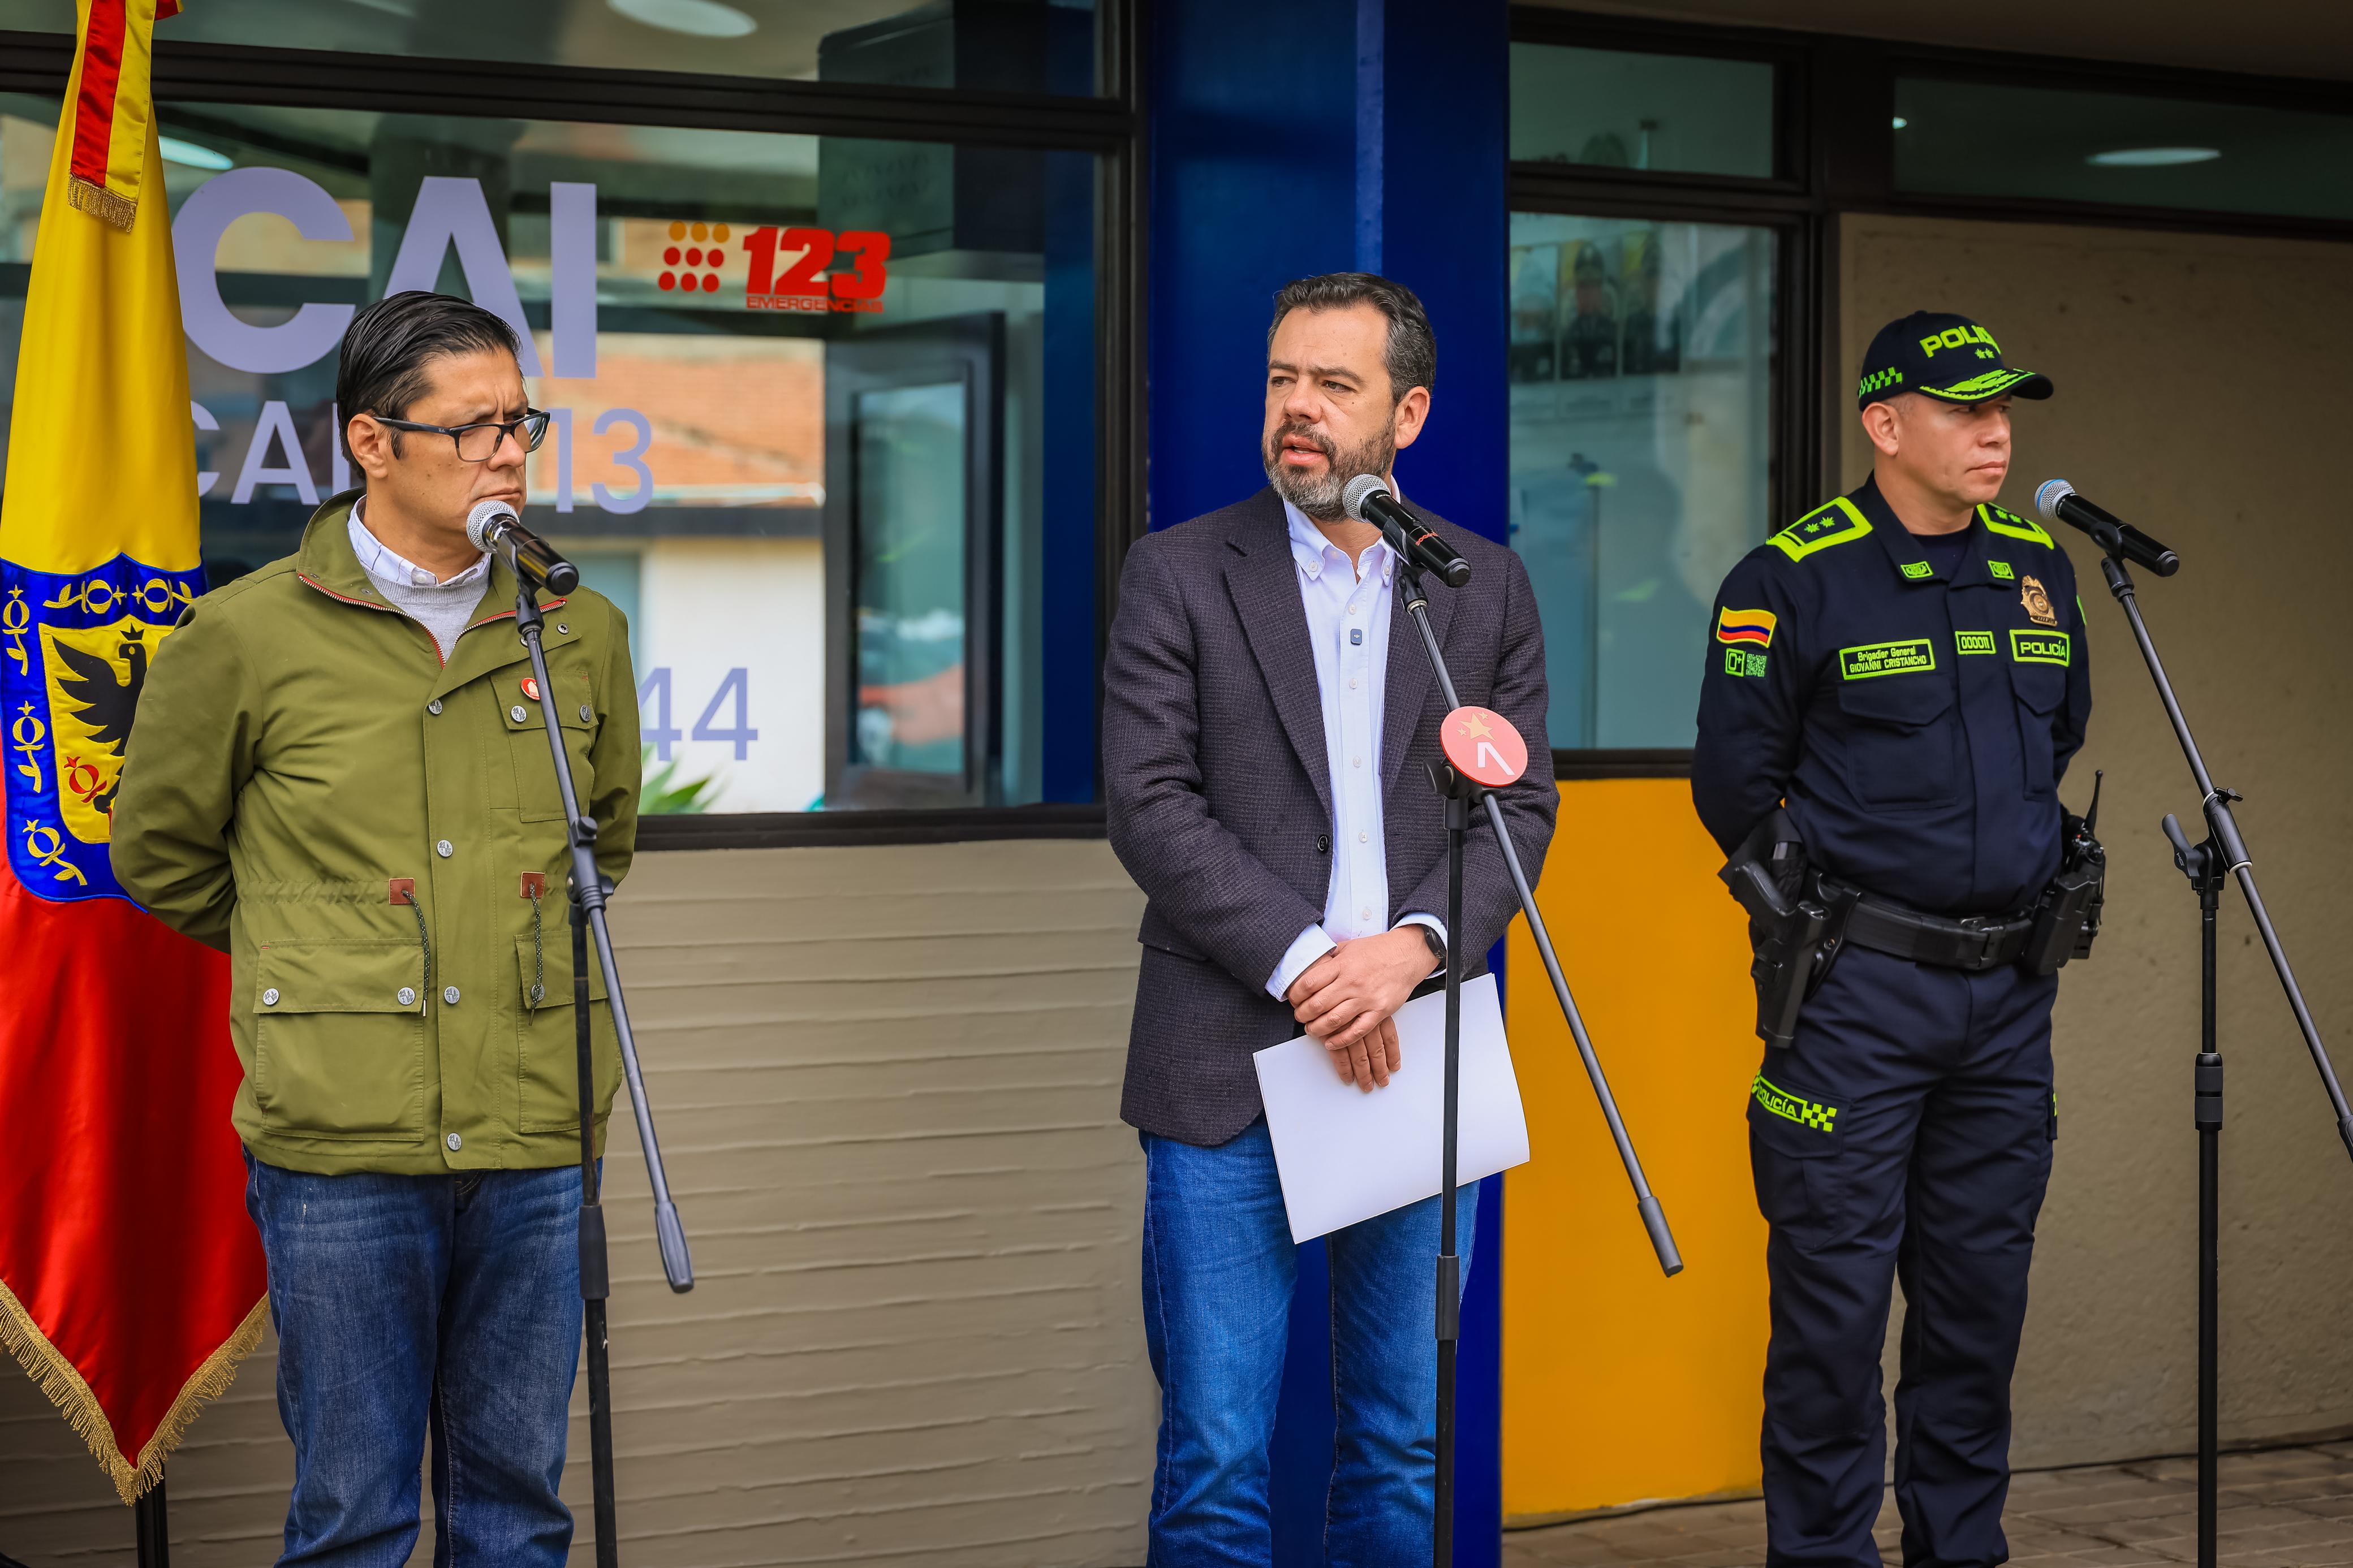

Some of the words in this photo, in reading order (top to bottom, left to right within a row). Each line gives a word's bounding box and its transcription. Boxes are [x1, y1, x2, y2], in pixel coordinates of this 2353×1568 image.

[743, 226, 890, 299] 123
[746, 296, 884, 314] EMERGENCIAS
[1961, 636, 1990, 650] 000011
[2020, 640, 2066, 658] POLICÍA
[1858, 650, 1889, 662] Brigadier
[1890, 646, 1916, 658] General
[1850, 660, 1882, 673] GIOVANNI
[1884, 655, 1927, 668] CRISTANCHO
